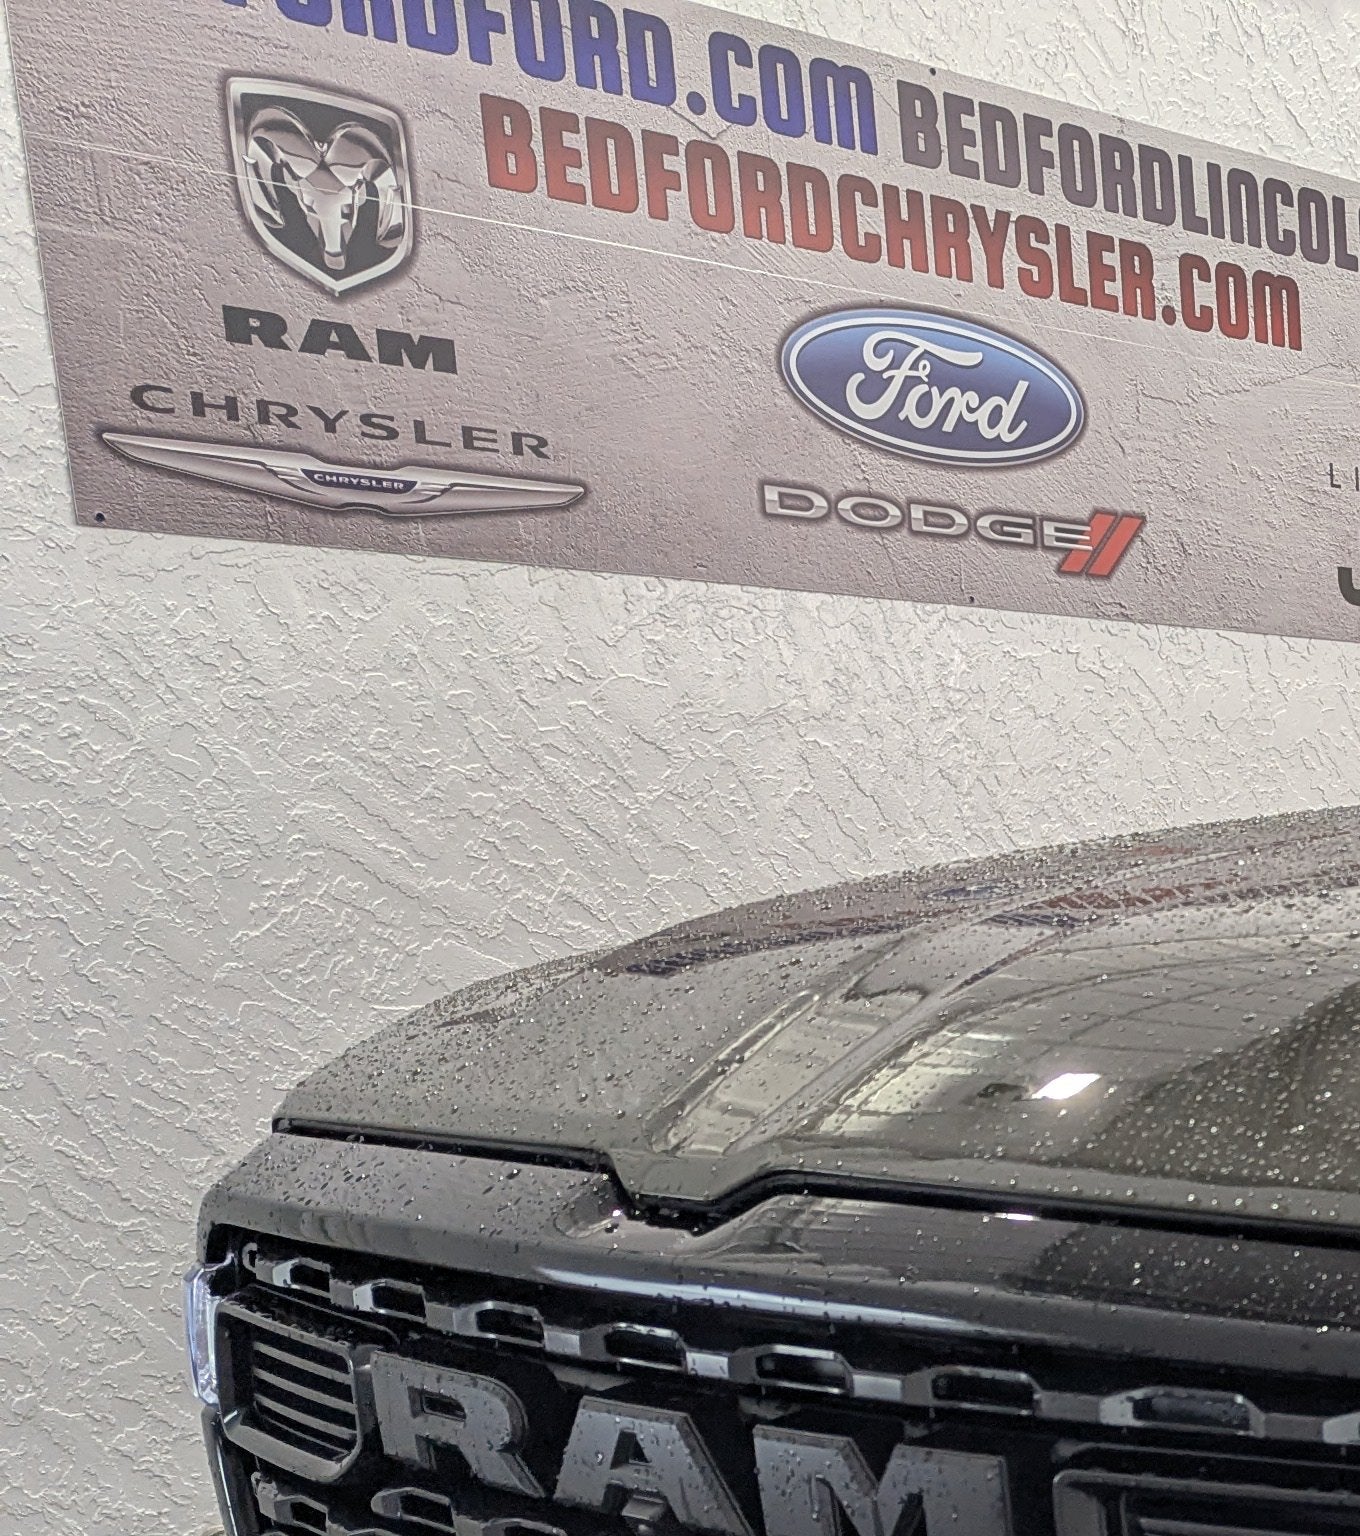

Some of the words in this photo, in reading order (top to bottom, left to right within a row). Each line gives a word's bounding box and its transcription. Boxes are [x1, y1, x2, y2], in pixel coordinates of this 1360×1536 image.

[479, 93, 1302, 352] BEDFORDCHRYSLER.COM
[222, 305, 458, 374] RAM
[130, 384, 551, 459] CHRYSLER
[845, 330, 1028, 444] Ford
[313, 473, 405, 489] CHRYSLER
[763, 484, 1092, 552] DODGE
